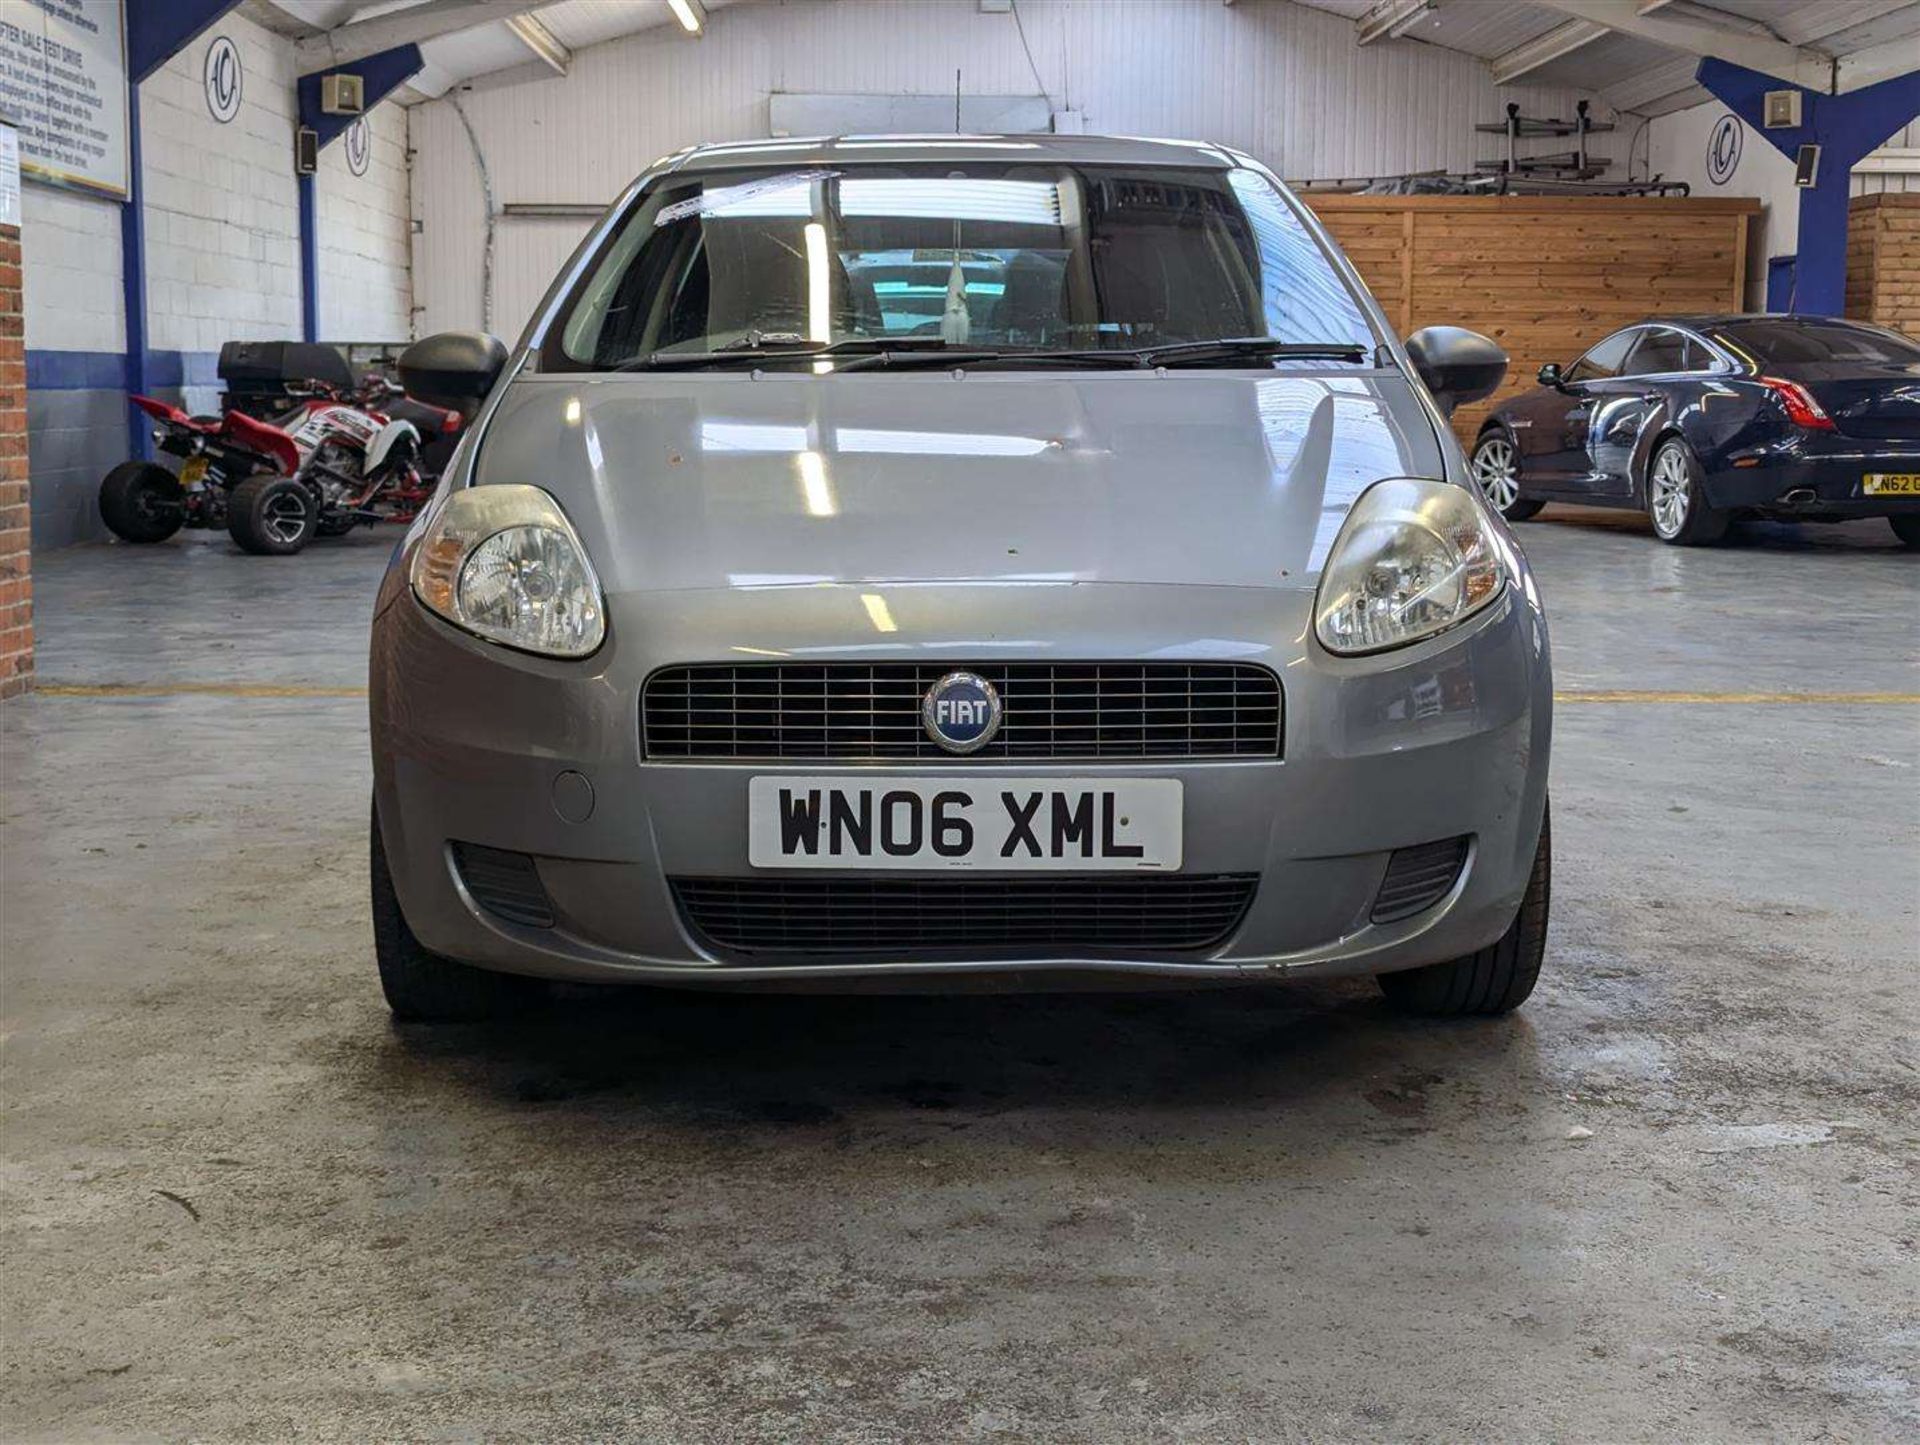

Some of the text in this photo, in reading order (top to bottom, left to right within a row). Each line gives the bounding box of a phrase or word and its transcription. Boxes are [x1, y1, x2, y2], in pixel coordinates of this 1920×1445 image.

[22, 30, 42, 53] SALE
[43, 39, 60, 59] TEST
[936, 700, 988, 725] FIAT
[778, 788, 1144, 858] WN06 XML
